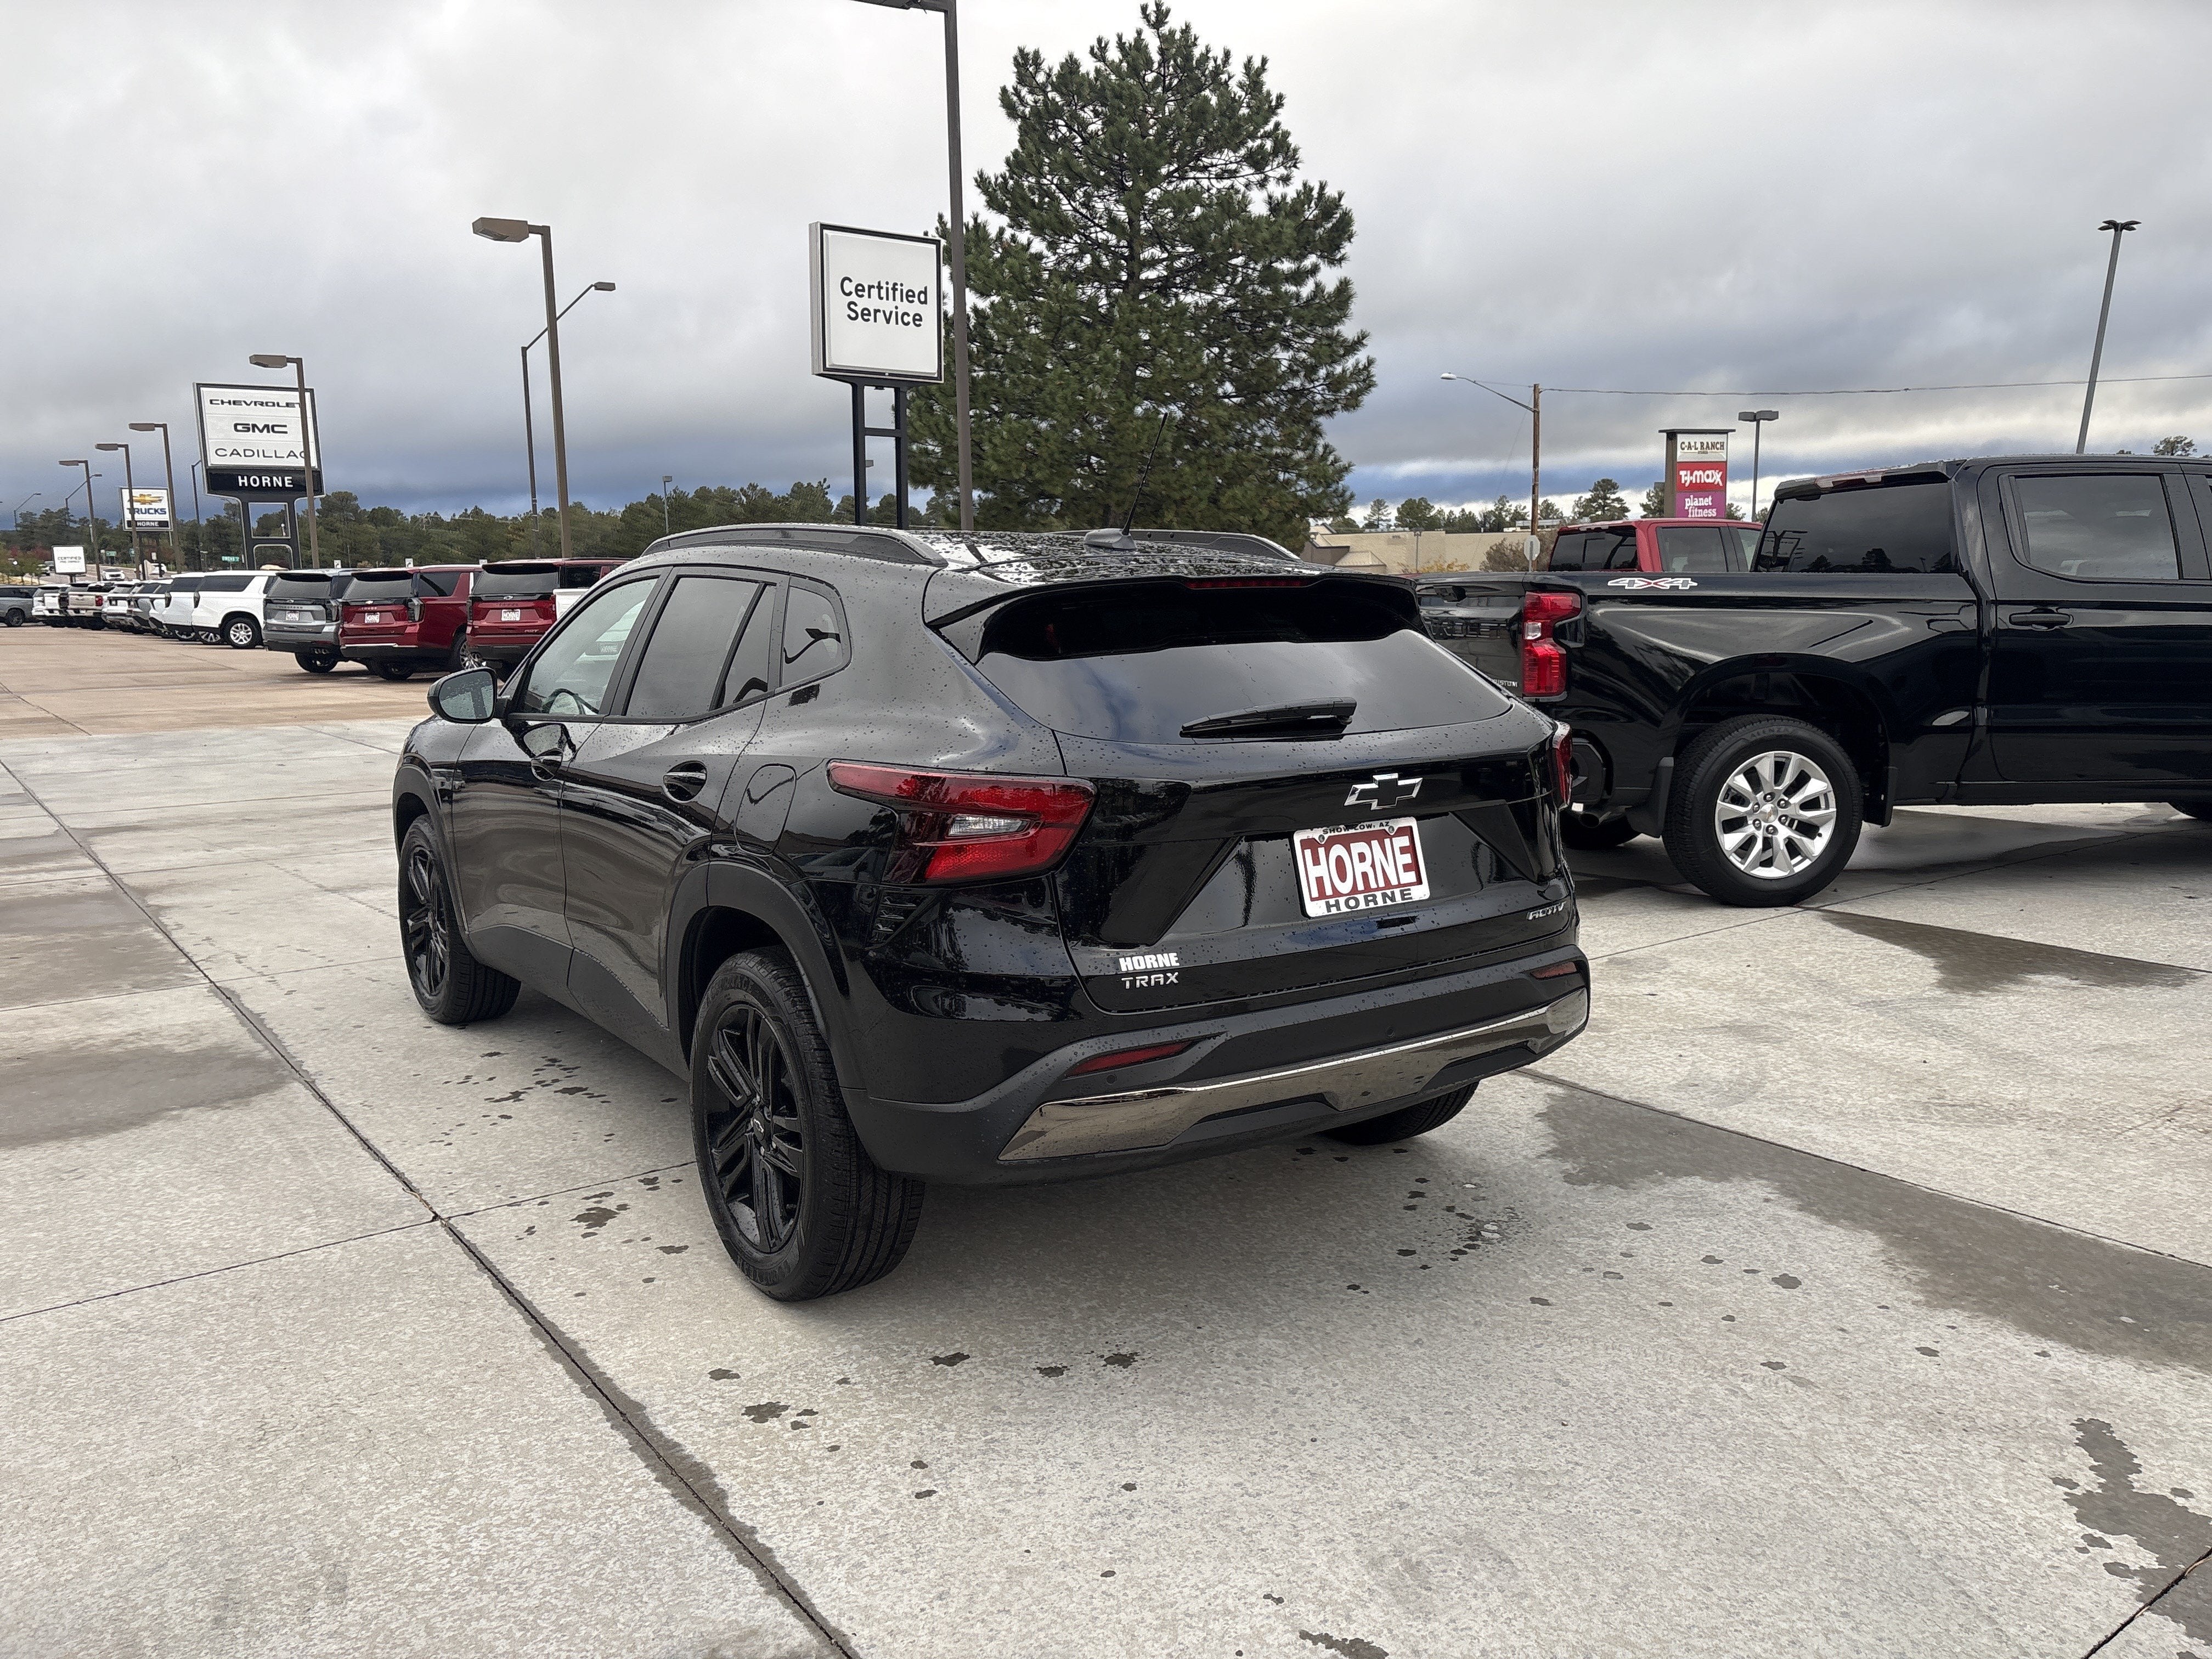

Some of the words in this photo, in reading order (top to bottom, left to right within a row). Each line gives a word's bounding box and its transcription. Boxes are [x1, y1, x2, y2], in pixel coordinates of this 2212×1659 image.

[840, 276, 928, 305] Certified
[847, 301, 923, 328] Service
[233, 422, 288, 434] GMC
[1700, 441, 1724, 450] RANCH
[238, 475, 294, 488] HORNE
[1684, 495, 1712, 510] planet
[1688, 506, 1717, 517] fitness
[1304, 836, 1417, 898] HORNE
[1324, 888, 1413, 913] HORNE
[1119, 952, 1180, 972] HORNE
[1121, 972, 1179, 989] TRAX
